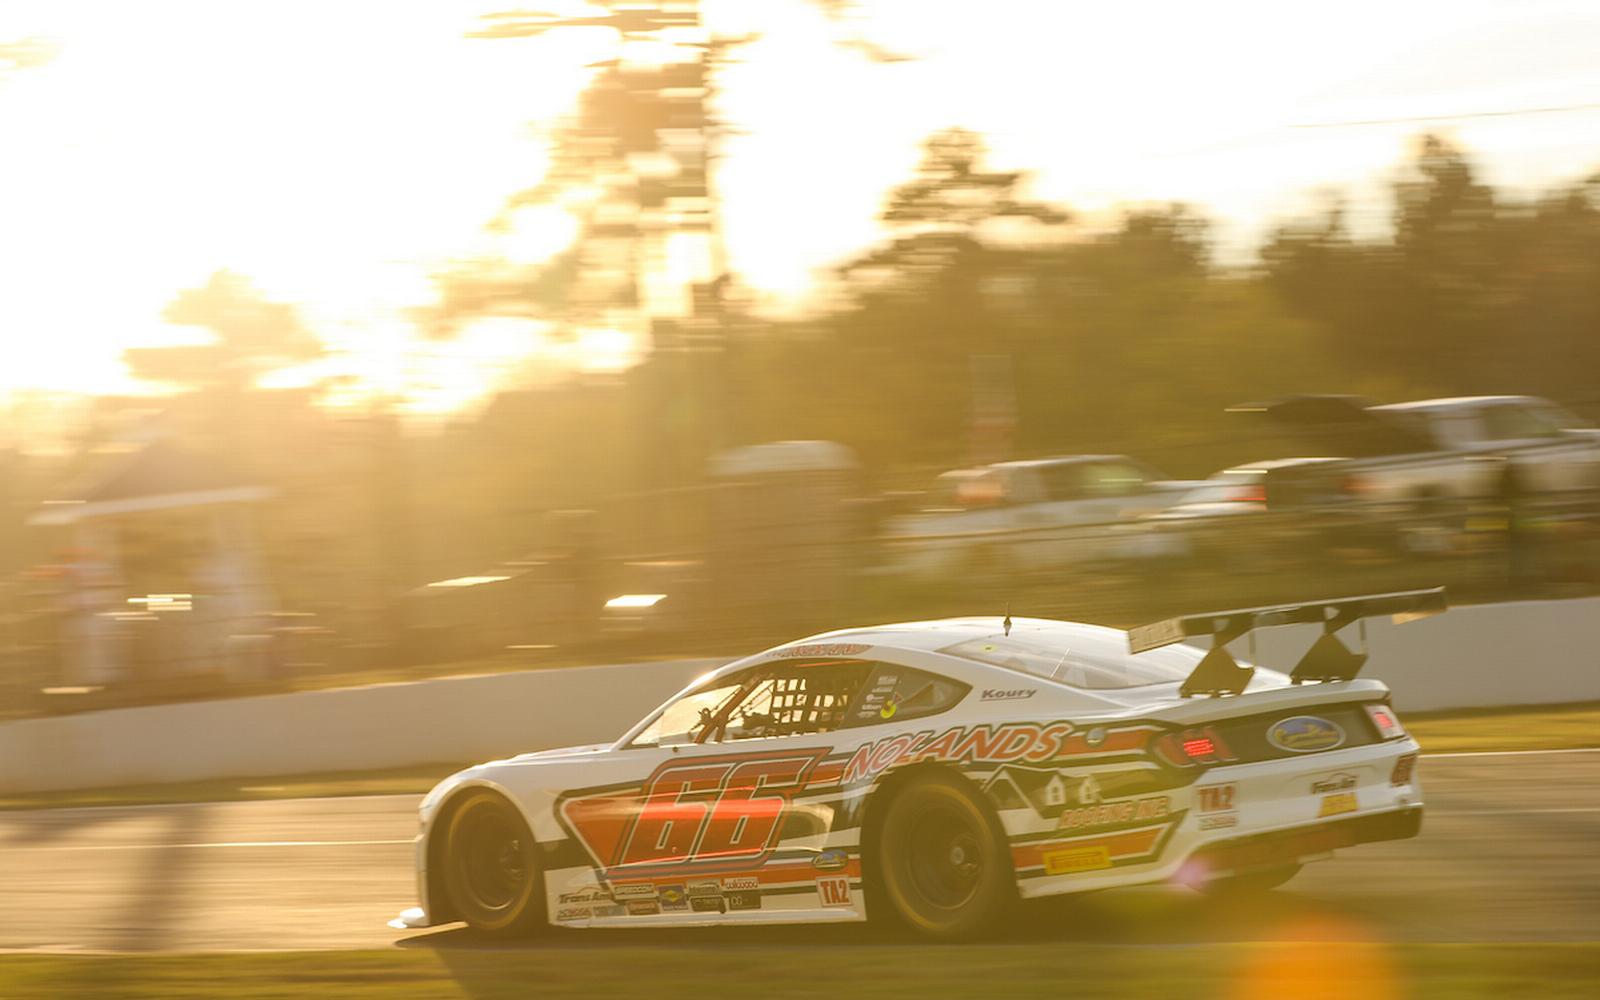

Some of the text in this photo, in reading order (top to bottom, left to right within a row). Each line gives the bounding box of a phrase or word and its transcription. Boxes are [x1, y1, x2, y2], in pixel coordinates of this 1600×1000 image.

[981, 687, 1038, 701] Koury
[843, 720, 1073, 784] NOLANDS
[618, 751, 820, 868] 66
[820, 879, 850, 905] TA2
